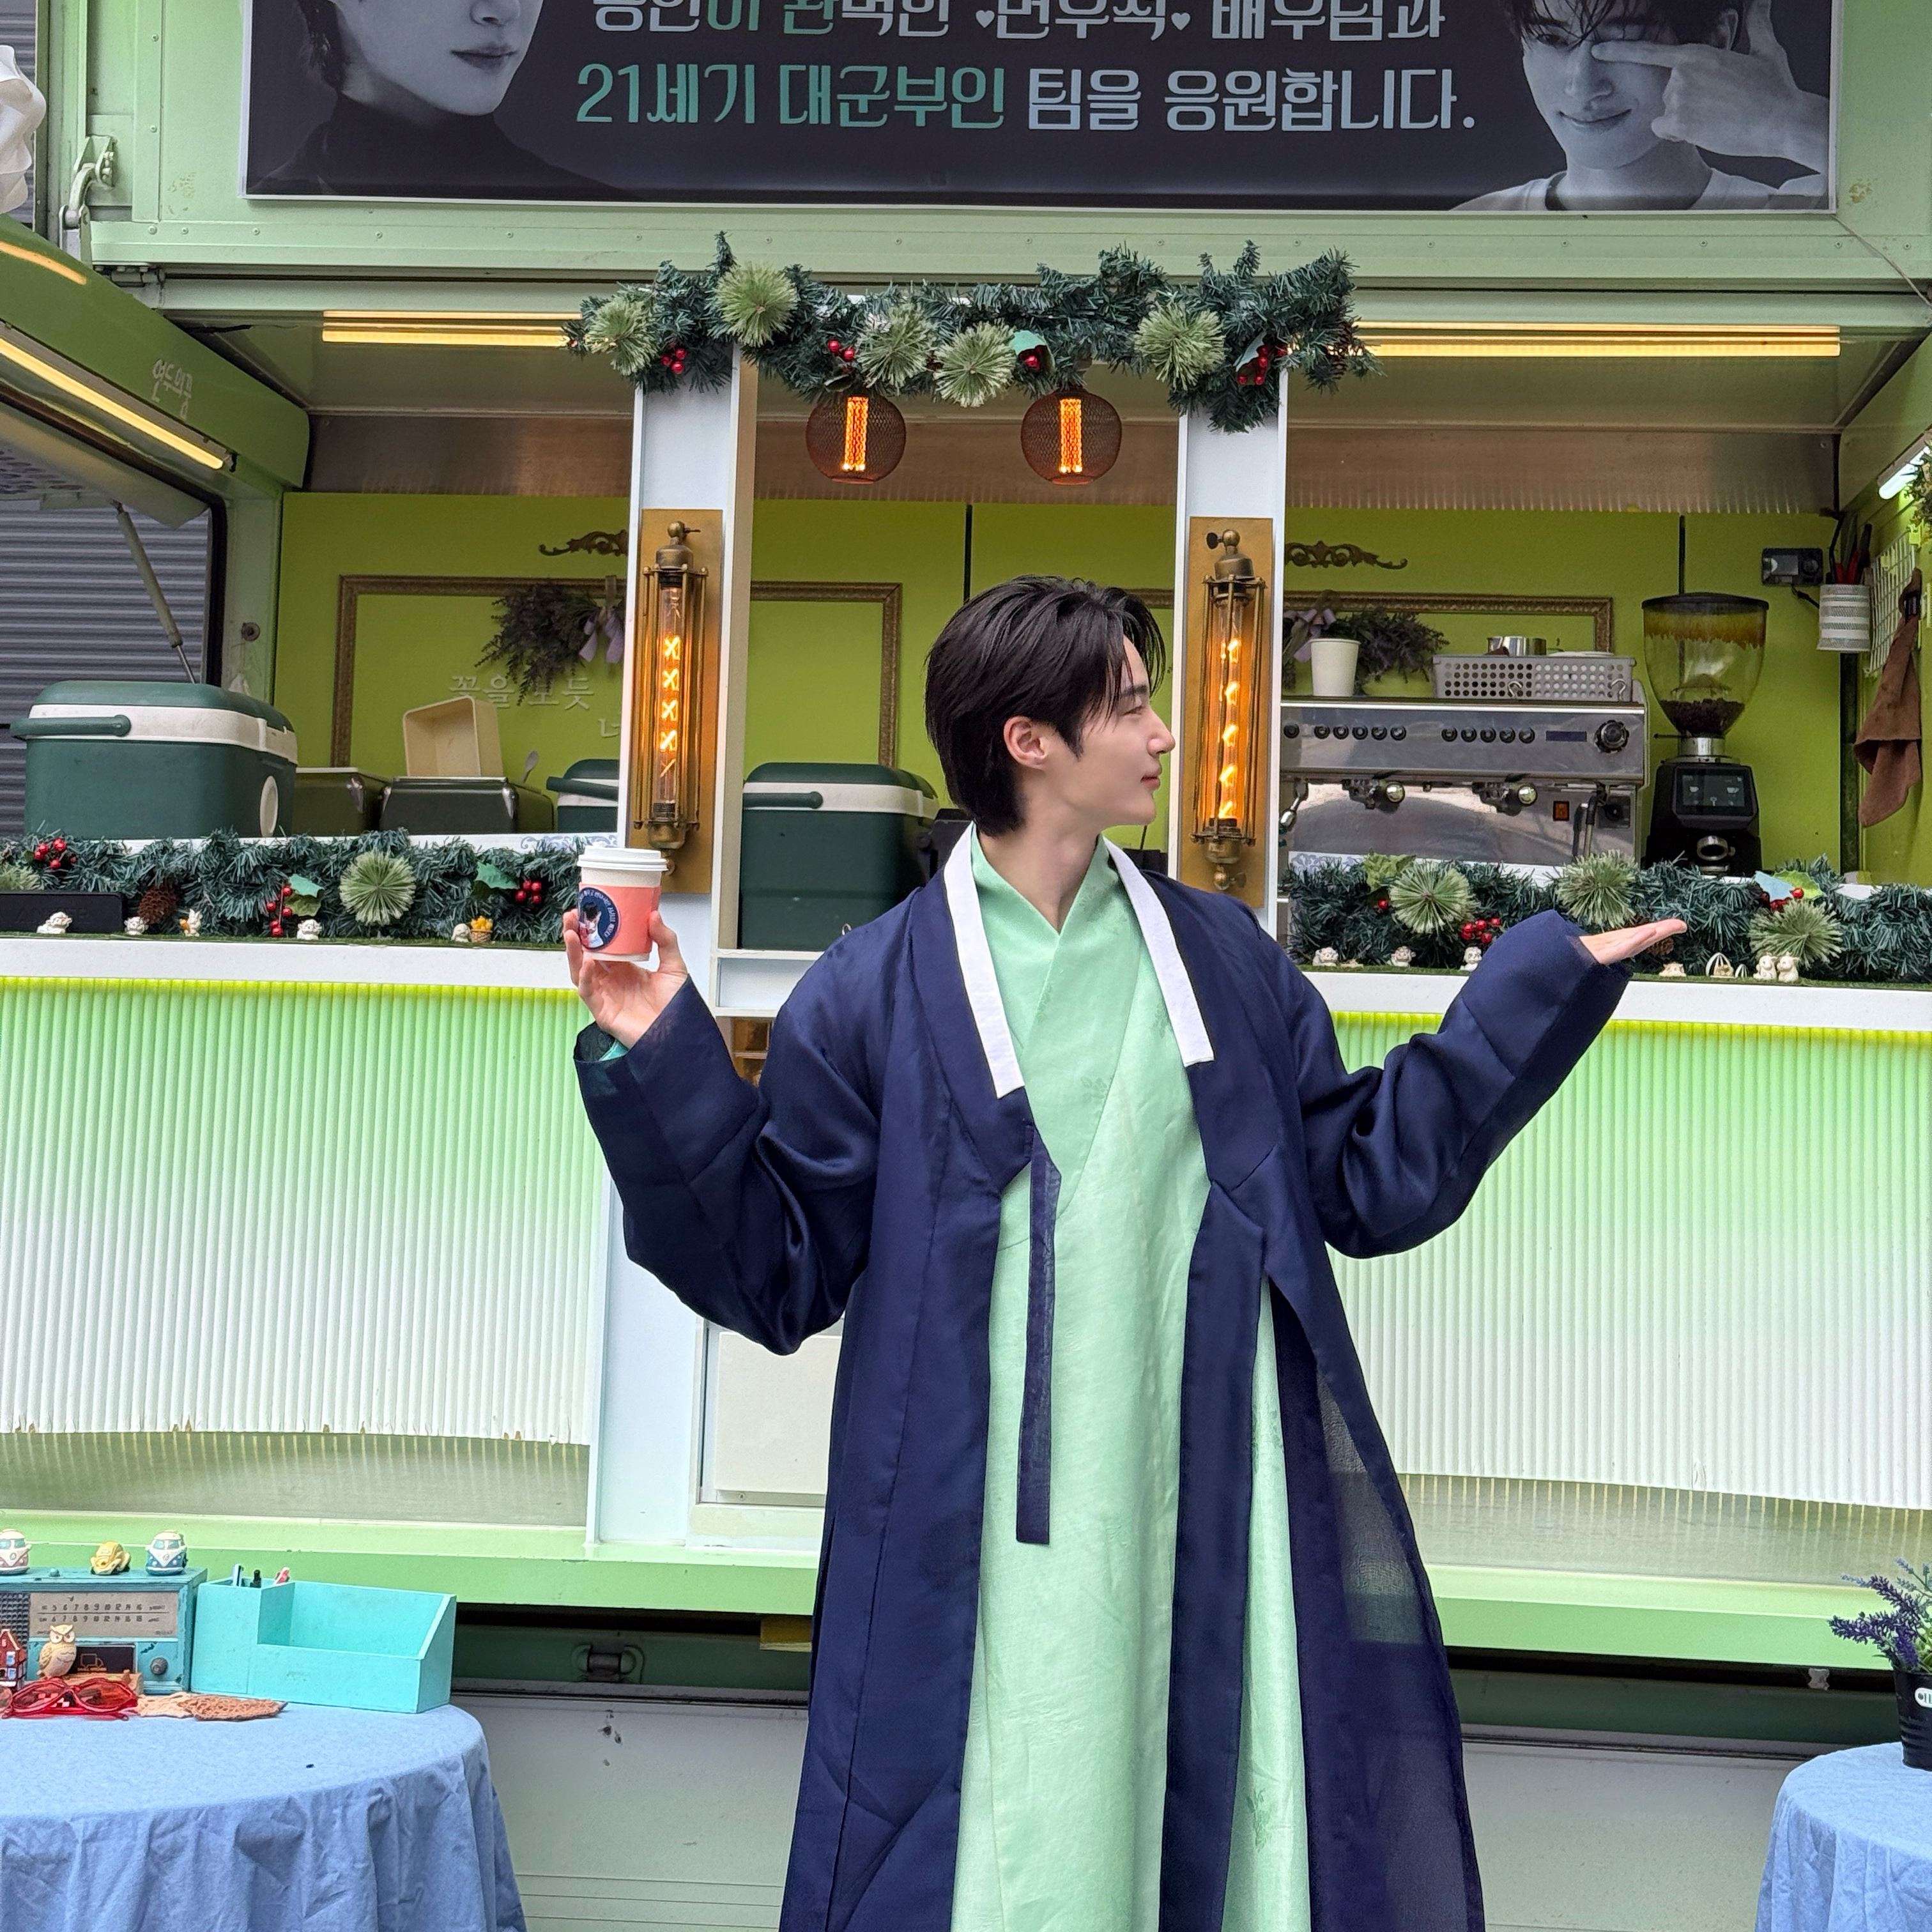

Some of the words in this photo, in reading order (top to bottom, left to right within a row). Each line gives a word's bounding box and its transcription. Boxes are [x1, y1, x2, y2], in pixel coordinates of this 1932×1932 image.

[1211, 0, 1446, 42] 배우님과
[576, 63, 755, 124] 21세기
[779, 65, 1005, 129] 대군부인
[1028, 68, 1142, 131] 팀을
[1164, 68, 1475, 132] 응원합니다.
